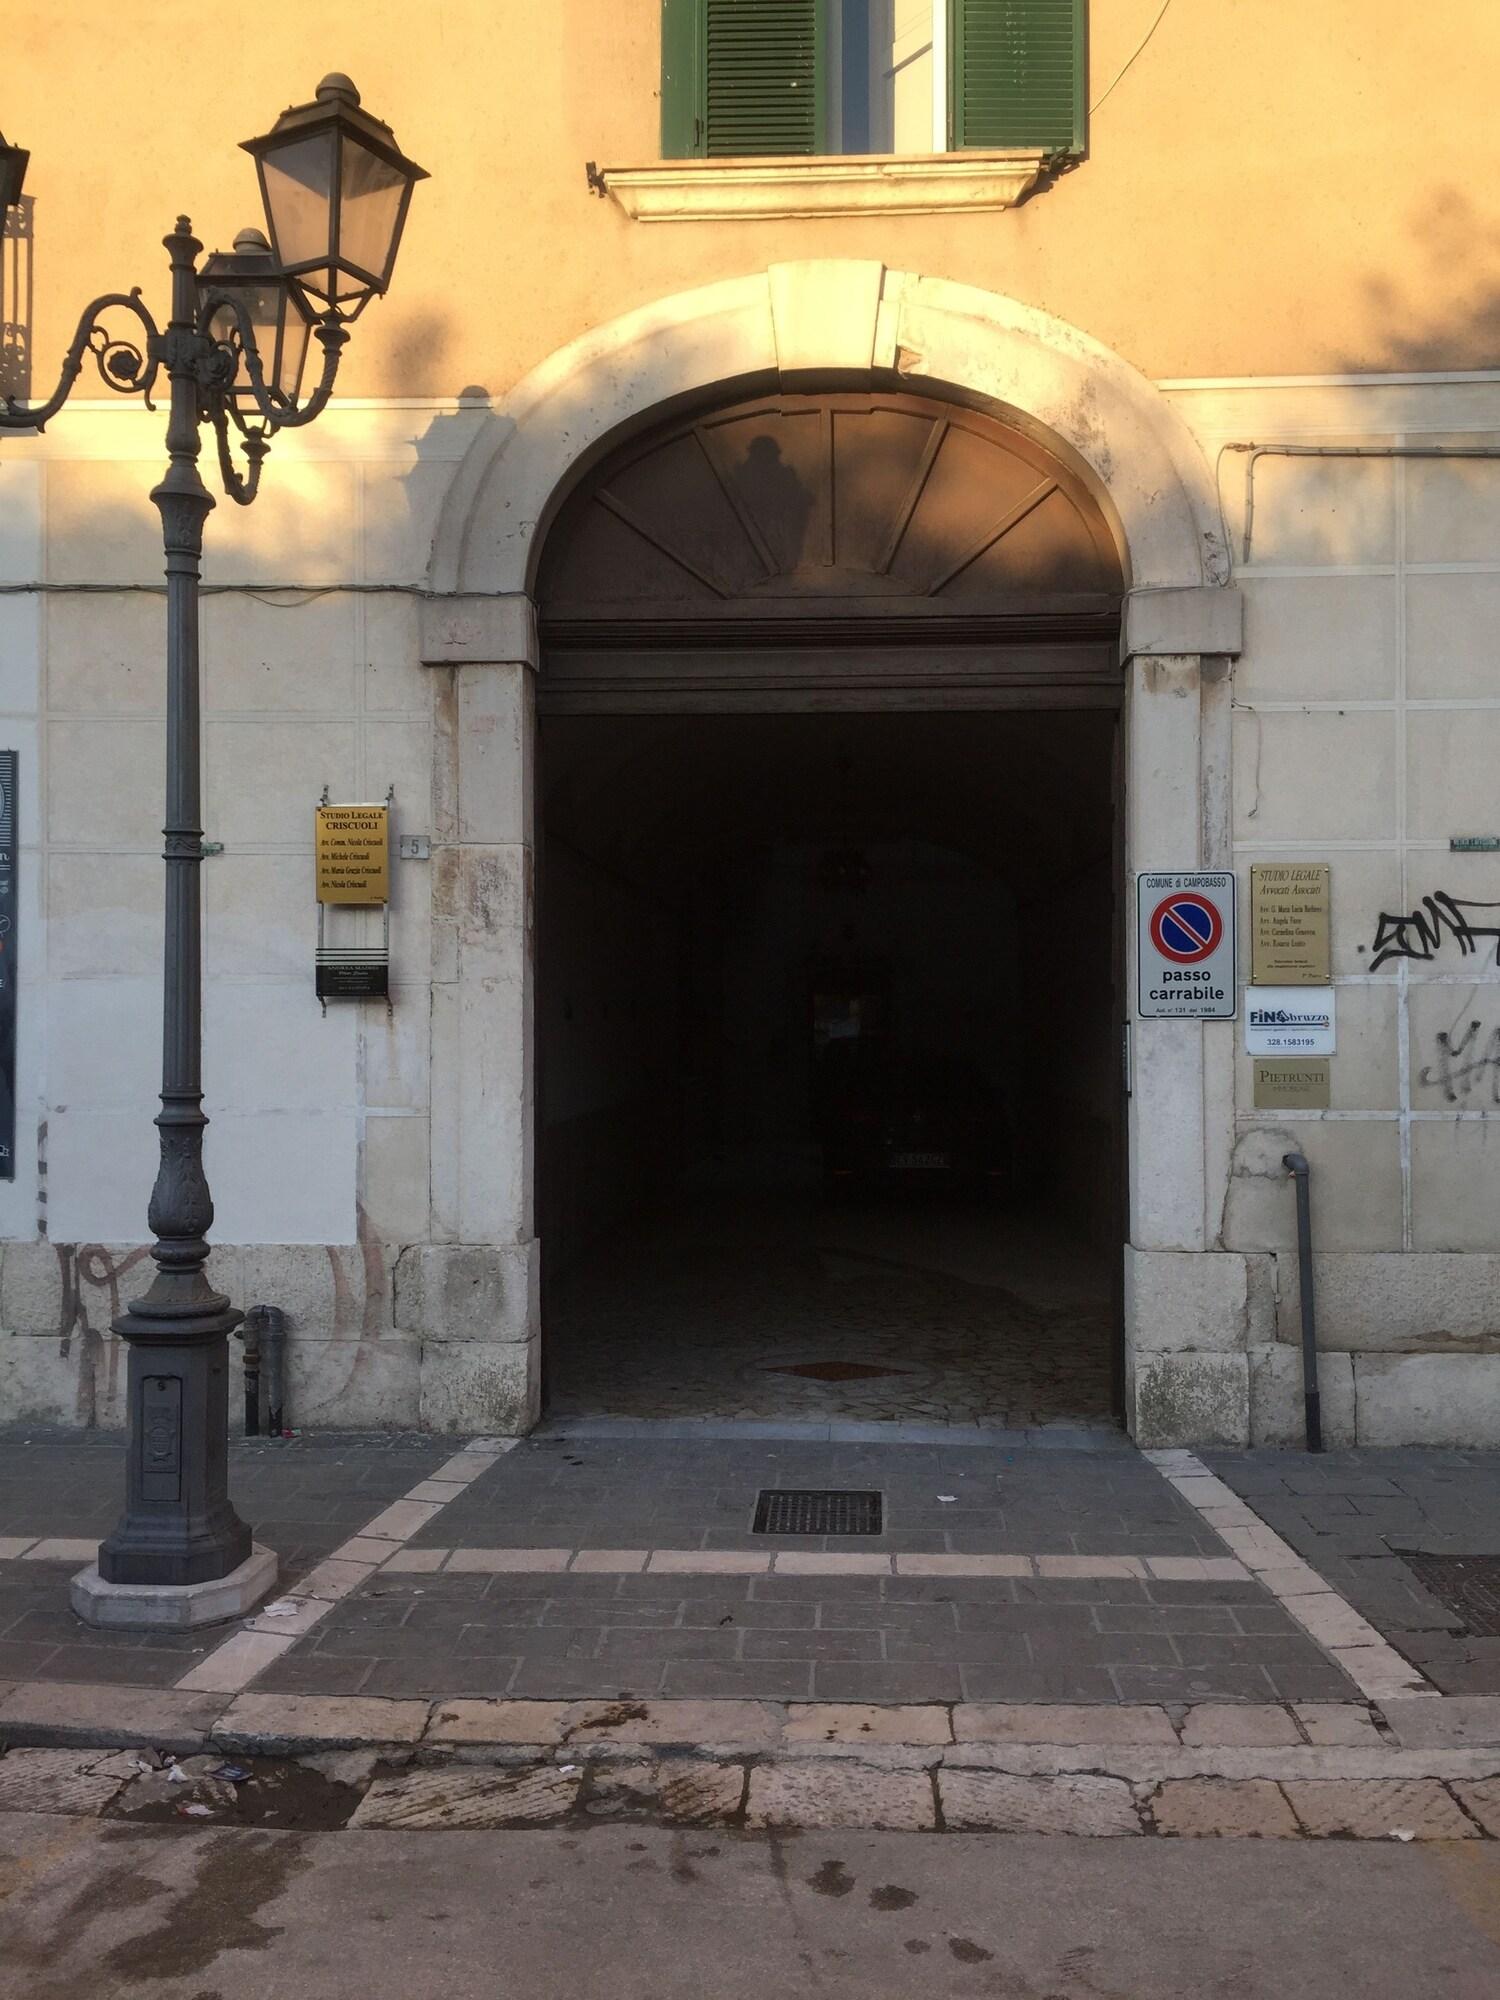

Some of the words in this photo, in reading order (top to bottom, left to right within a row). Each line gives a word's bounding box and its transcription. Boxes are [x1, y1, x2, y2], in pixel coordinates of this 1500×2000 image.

[411, 840, 419, 854] 5
[1258, 870, 1290, 881] STUDIO
[1290, 870, 1321, 881] LEGALE
[1147, 878, 1172, 888] COMUNE
[1175, 878, 1181, 888] di
[1184, 877, 1226, 888] CAMPOBASSO
[1260, 884, 1289, 895] Avvocati
[1163, 971, 1211, 984] passo
[1150, 986, 1224, 1000] carrabile
[1259, 1070, 1324, 1082] PIETRUNTI
